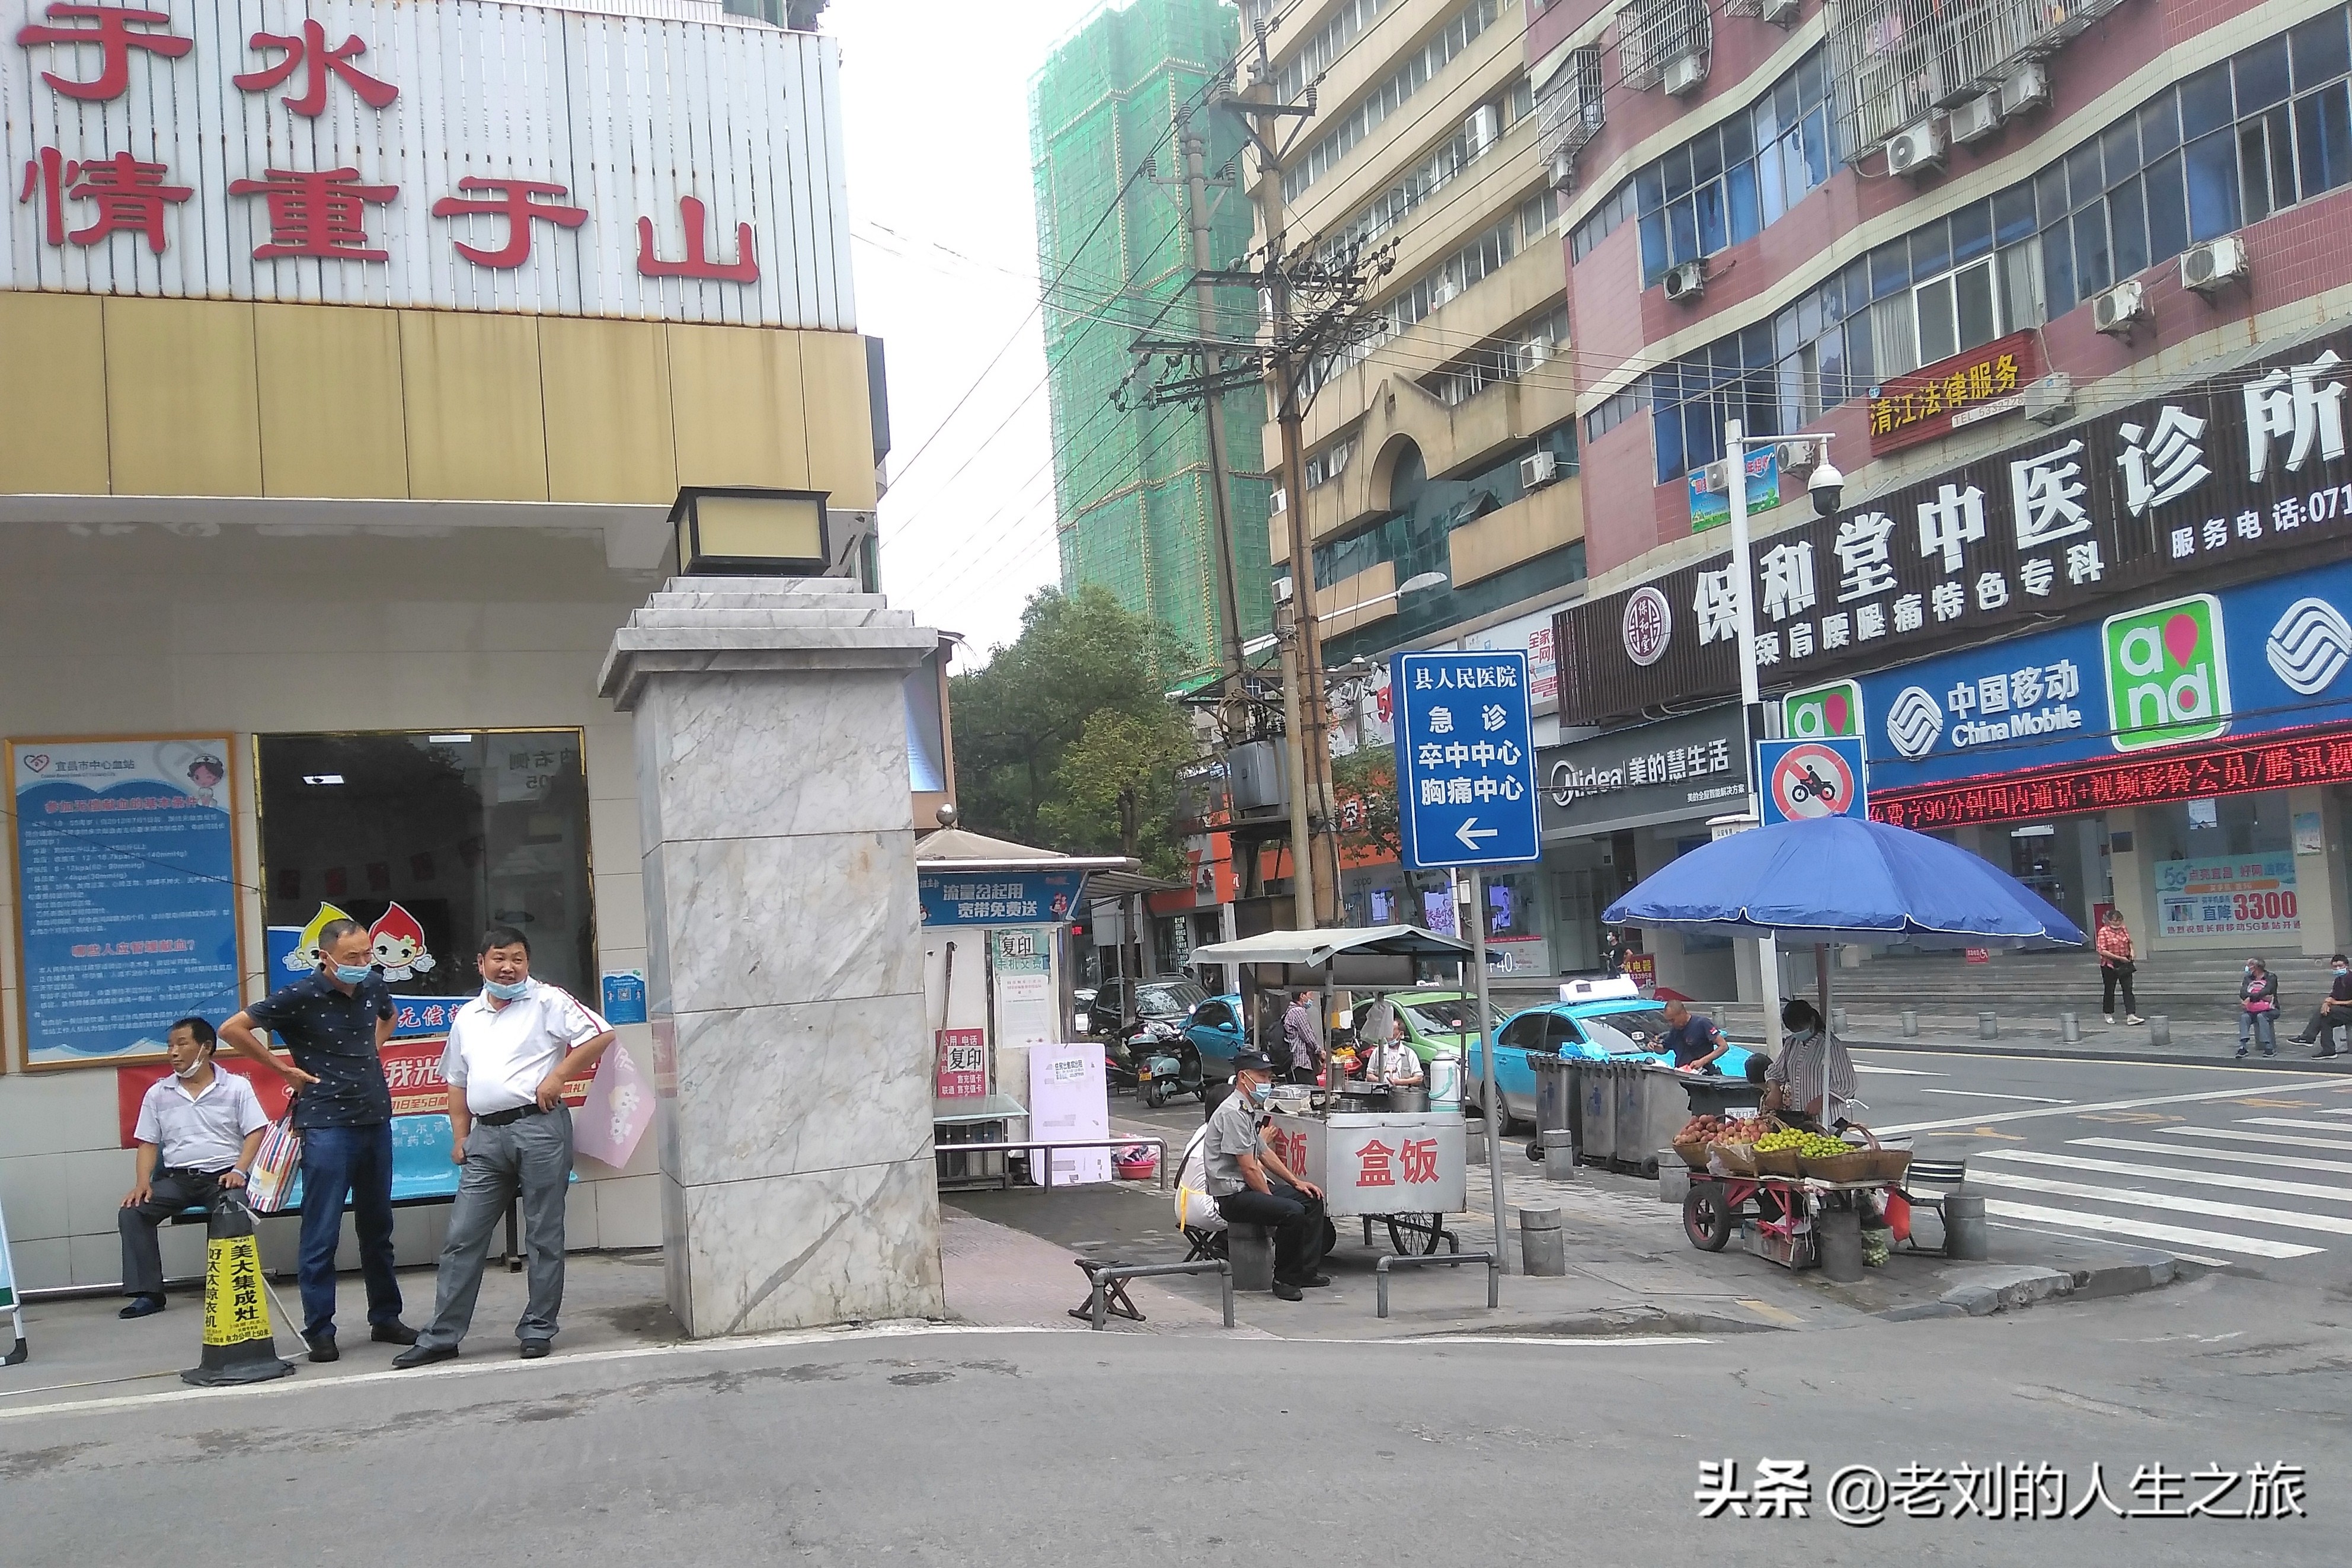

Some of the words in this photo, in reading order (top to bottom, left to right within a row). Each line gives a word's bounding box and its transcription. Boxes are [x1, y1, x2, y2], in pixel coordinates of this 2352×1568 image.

[17, 2, 401, 119] 于水
[19, 145, 762, 286] 情重于山
[1870, 354, 2018, 437] 清江法律服务
[1954, 410, 1973, 425] TEL
[1693, 349, 2347, 646] 保和堂中医诊所
[1755, 540, 2104, 667] 颈肩腰腿痛特色专科
[1529, 626, 1554, 649] 全家
[1413, 665, 1517, 690] 县人民医院
[1947, 658, 2079, 719] 中国移动
[1428, 704, 1507, 734] 急诊
[1951, 721, 2010, 748] China
[2011, 703, 2082, 738] Mobile
[55, 759, 135, 772] 宜昌市中心血站
[1418, 739, 1522, 770] 卒中中心
[1629, 738, 1730, 784] 美的慧生活
[44, 795, 199, 814] 参加无偿献血的基本条件
[1421, 774, 1525, 806] 胸痛中心
[958, 901, 1037, 919] 宽带免费送
[2203, 904, 2232, 921] 直降
[2233, 891, 2298, 921] 3300
[1002, 935, 1031, 957] 复印
[961, 1035, 977, 1046] 电话
[949, 1047, 982, 1070] 复印
[942, 1086, 955, 1095] 联通
[1354, 1137, 1440, 1188] 盒饭
[231, 1244, 260, 1323] 美大集成灶
